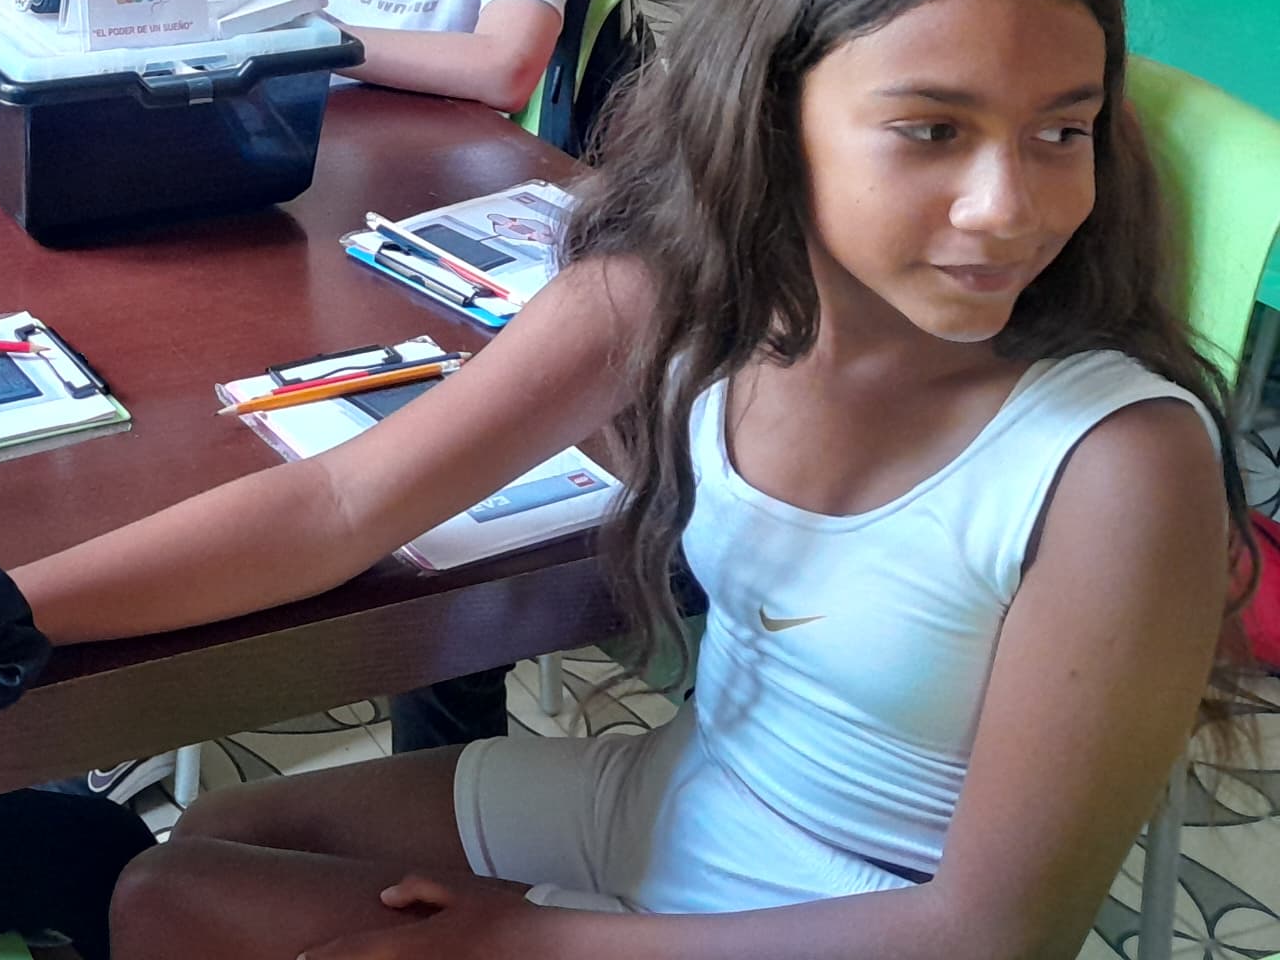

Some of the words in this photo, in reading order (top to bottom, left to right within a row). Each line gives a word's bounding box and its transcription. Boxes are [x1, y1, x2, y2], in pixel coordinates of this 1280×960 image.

[108, 26, 135, 36] PODER
[137, 25, 147, 34] DE
[150, 24, 161, 33] UN
